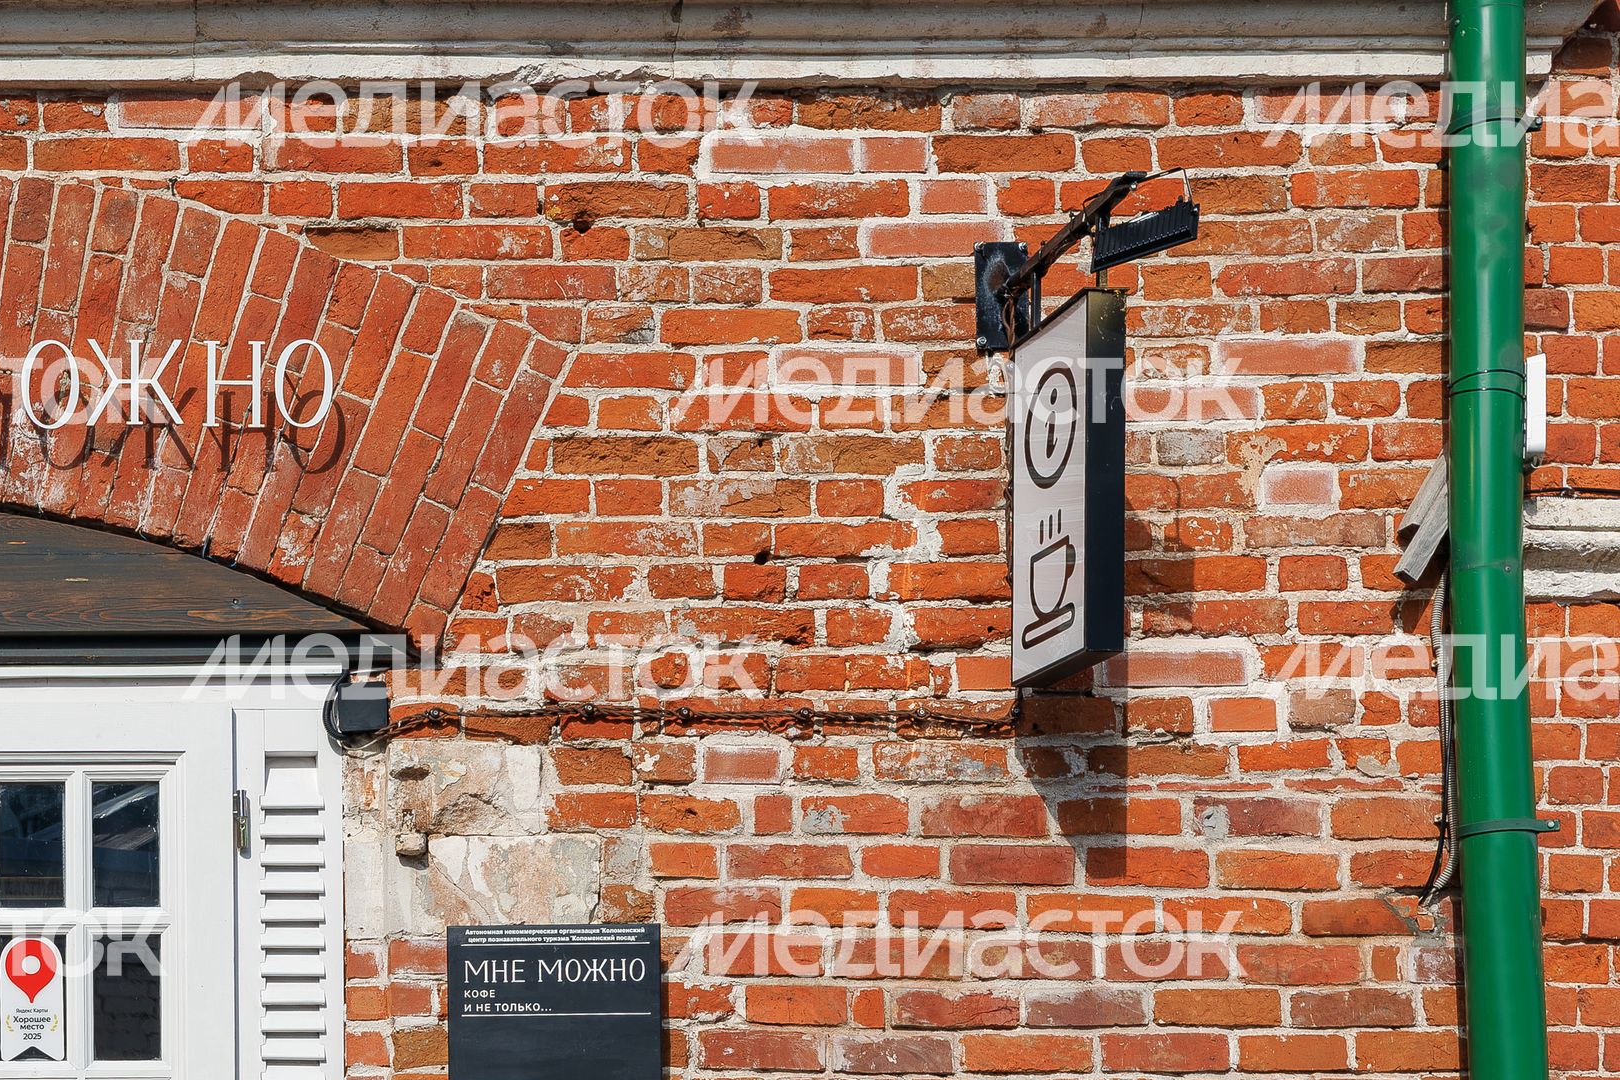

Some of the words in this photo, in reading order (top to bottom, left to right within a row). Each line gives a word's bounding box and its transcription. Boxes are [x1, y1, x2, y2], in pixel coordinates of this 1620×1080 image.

[464, 960, 525, 984] МНЕ
[538, 958, 646, 983] МОЖНО
[464, 990, 496, 998] КОФЕ
[464, 1004, 472, 1012] И
[476, 1003, 491, 1012] НЕ
[495, 1003, 552, 1012] ТОЛЬКО...
[12, 1016, 51, 1024] Хорошее
